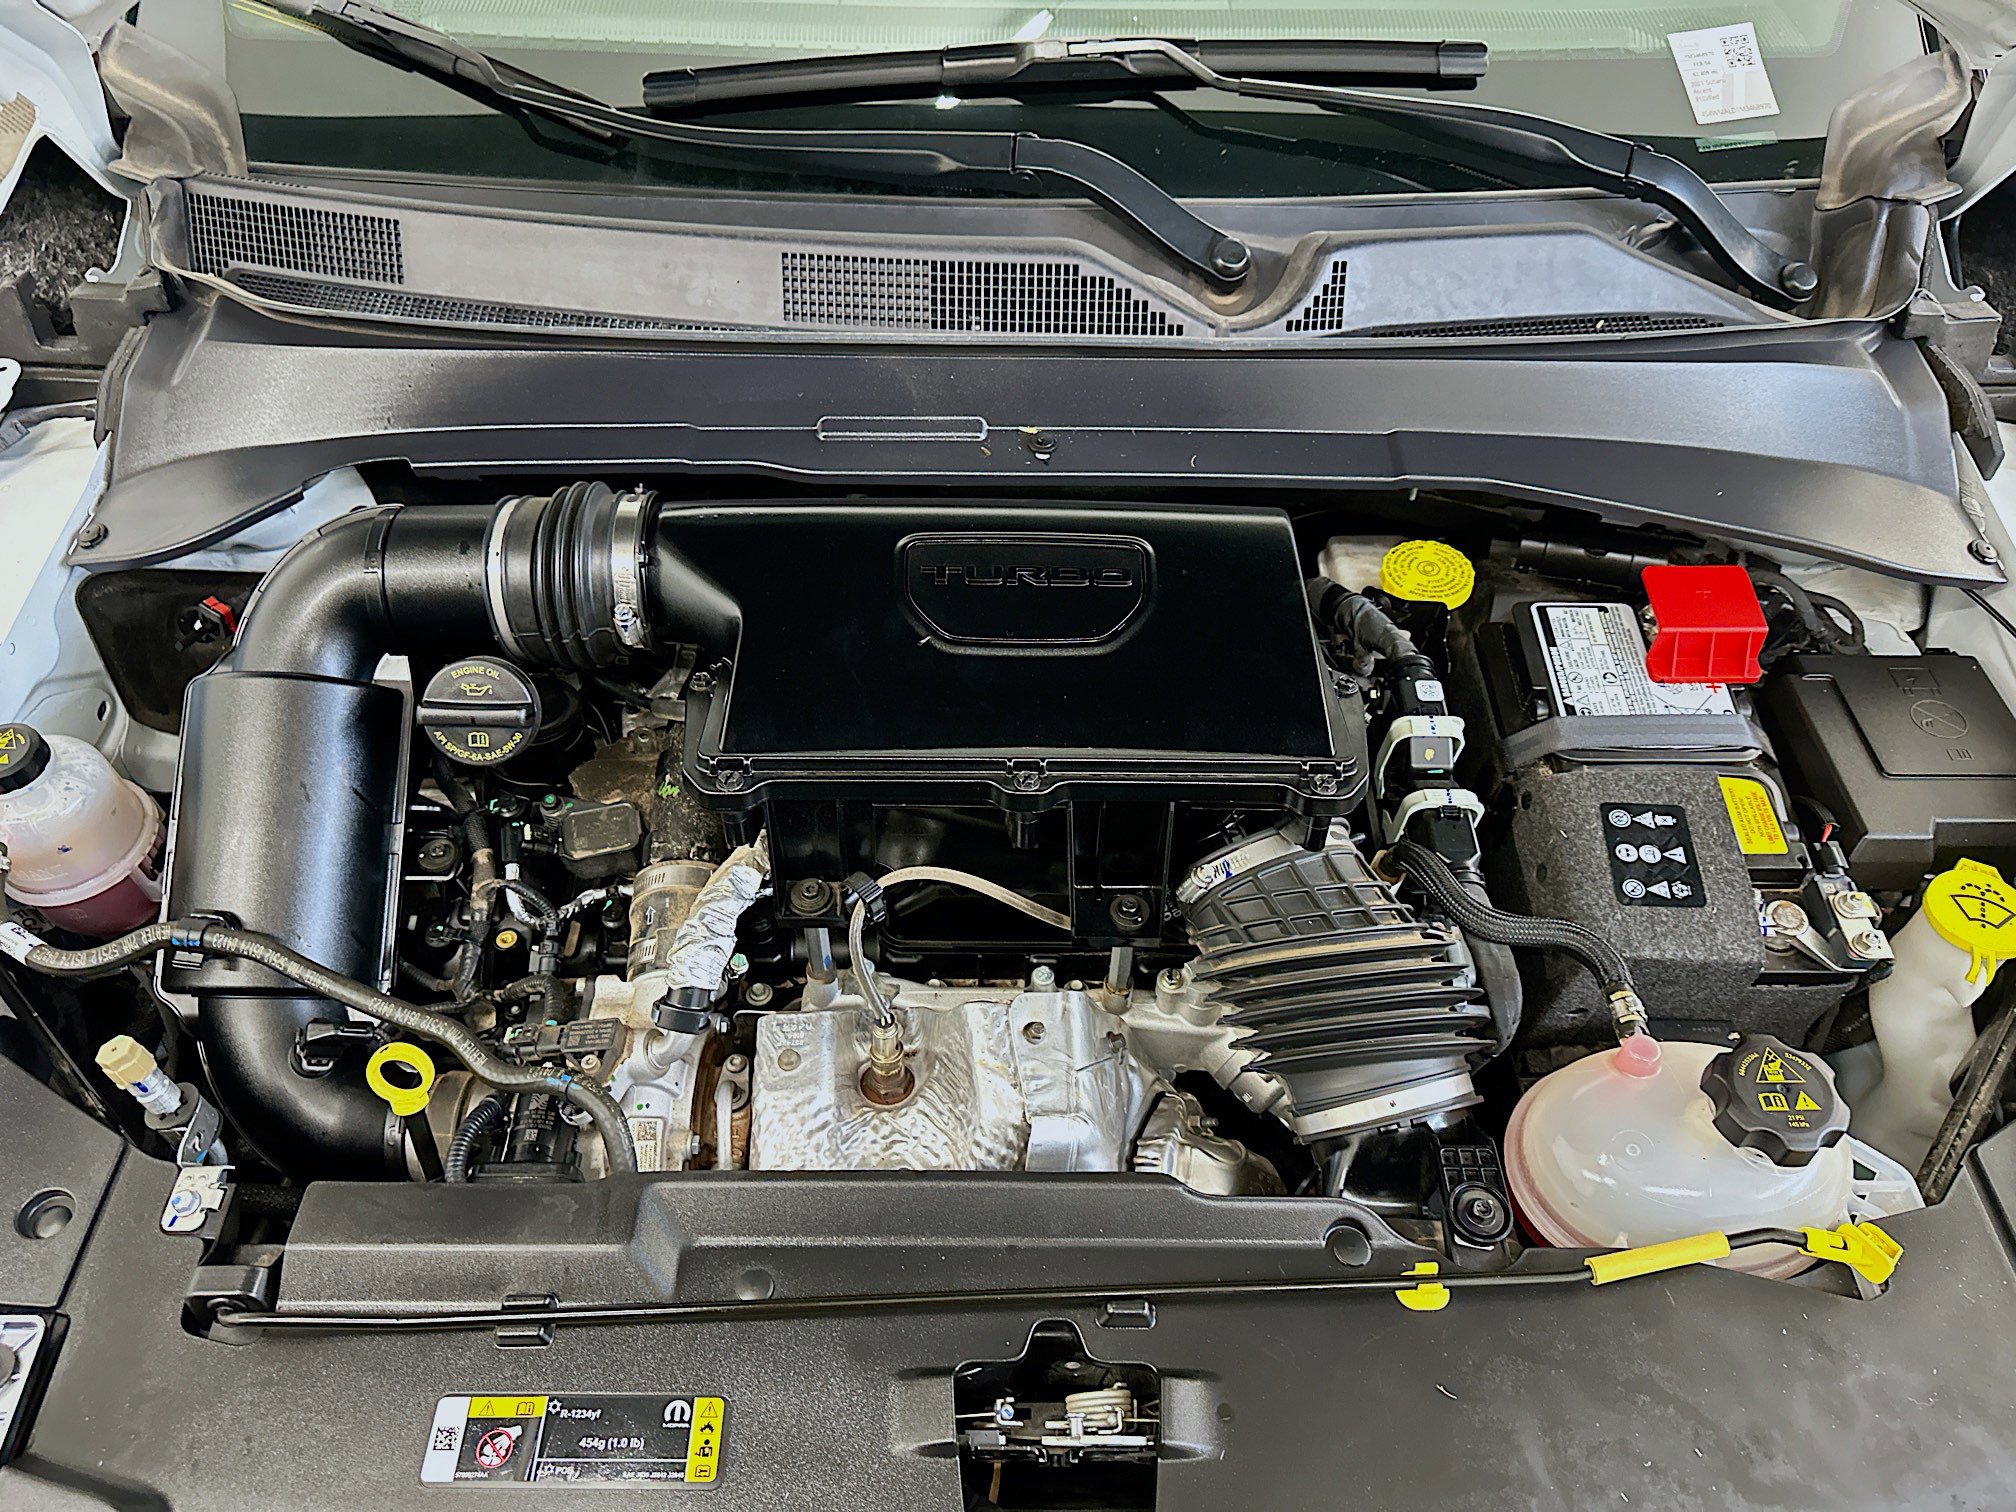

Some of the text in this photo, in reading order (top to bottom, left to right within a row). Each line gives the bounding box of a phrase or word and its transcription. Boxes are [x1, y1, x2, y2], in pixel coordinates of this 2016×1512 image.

[920, 565, 1133, 587] TURBO
[450, 666, 500, 680] ENGINE OIL
[433, 730, 448, 745] API
[142, 925, 171, 946] HEATER
[421, 1014, 448, 1036] 57512
[459, 1037, 488, 1069] HEATER
[560, 1409, 601, 1420] R-1234yf
[579, 1437, 645, 1450] 454g (1.0 lb)
